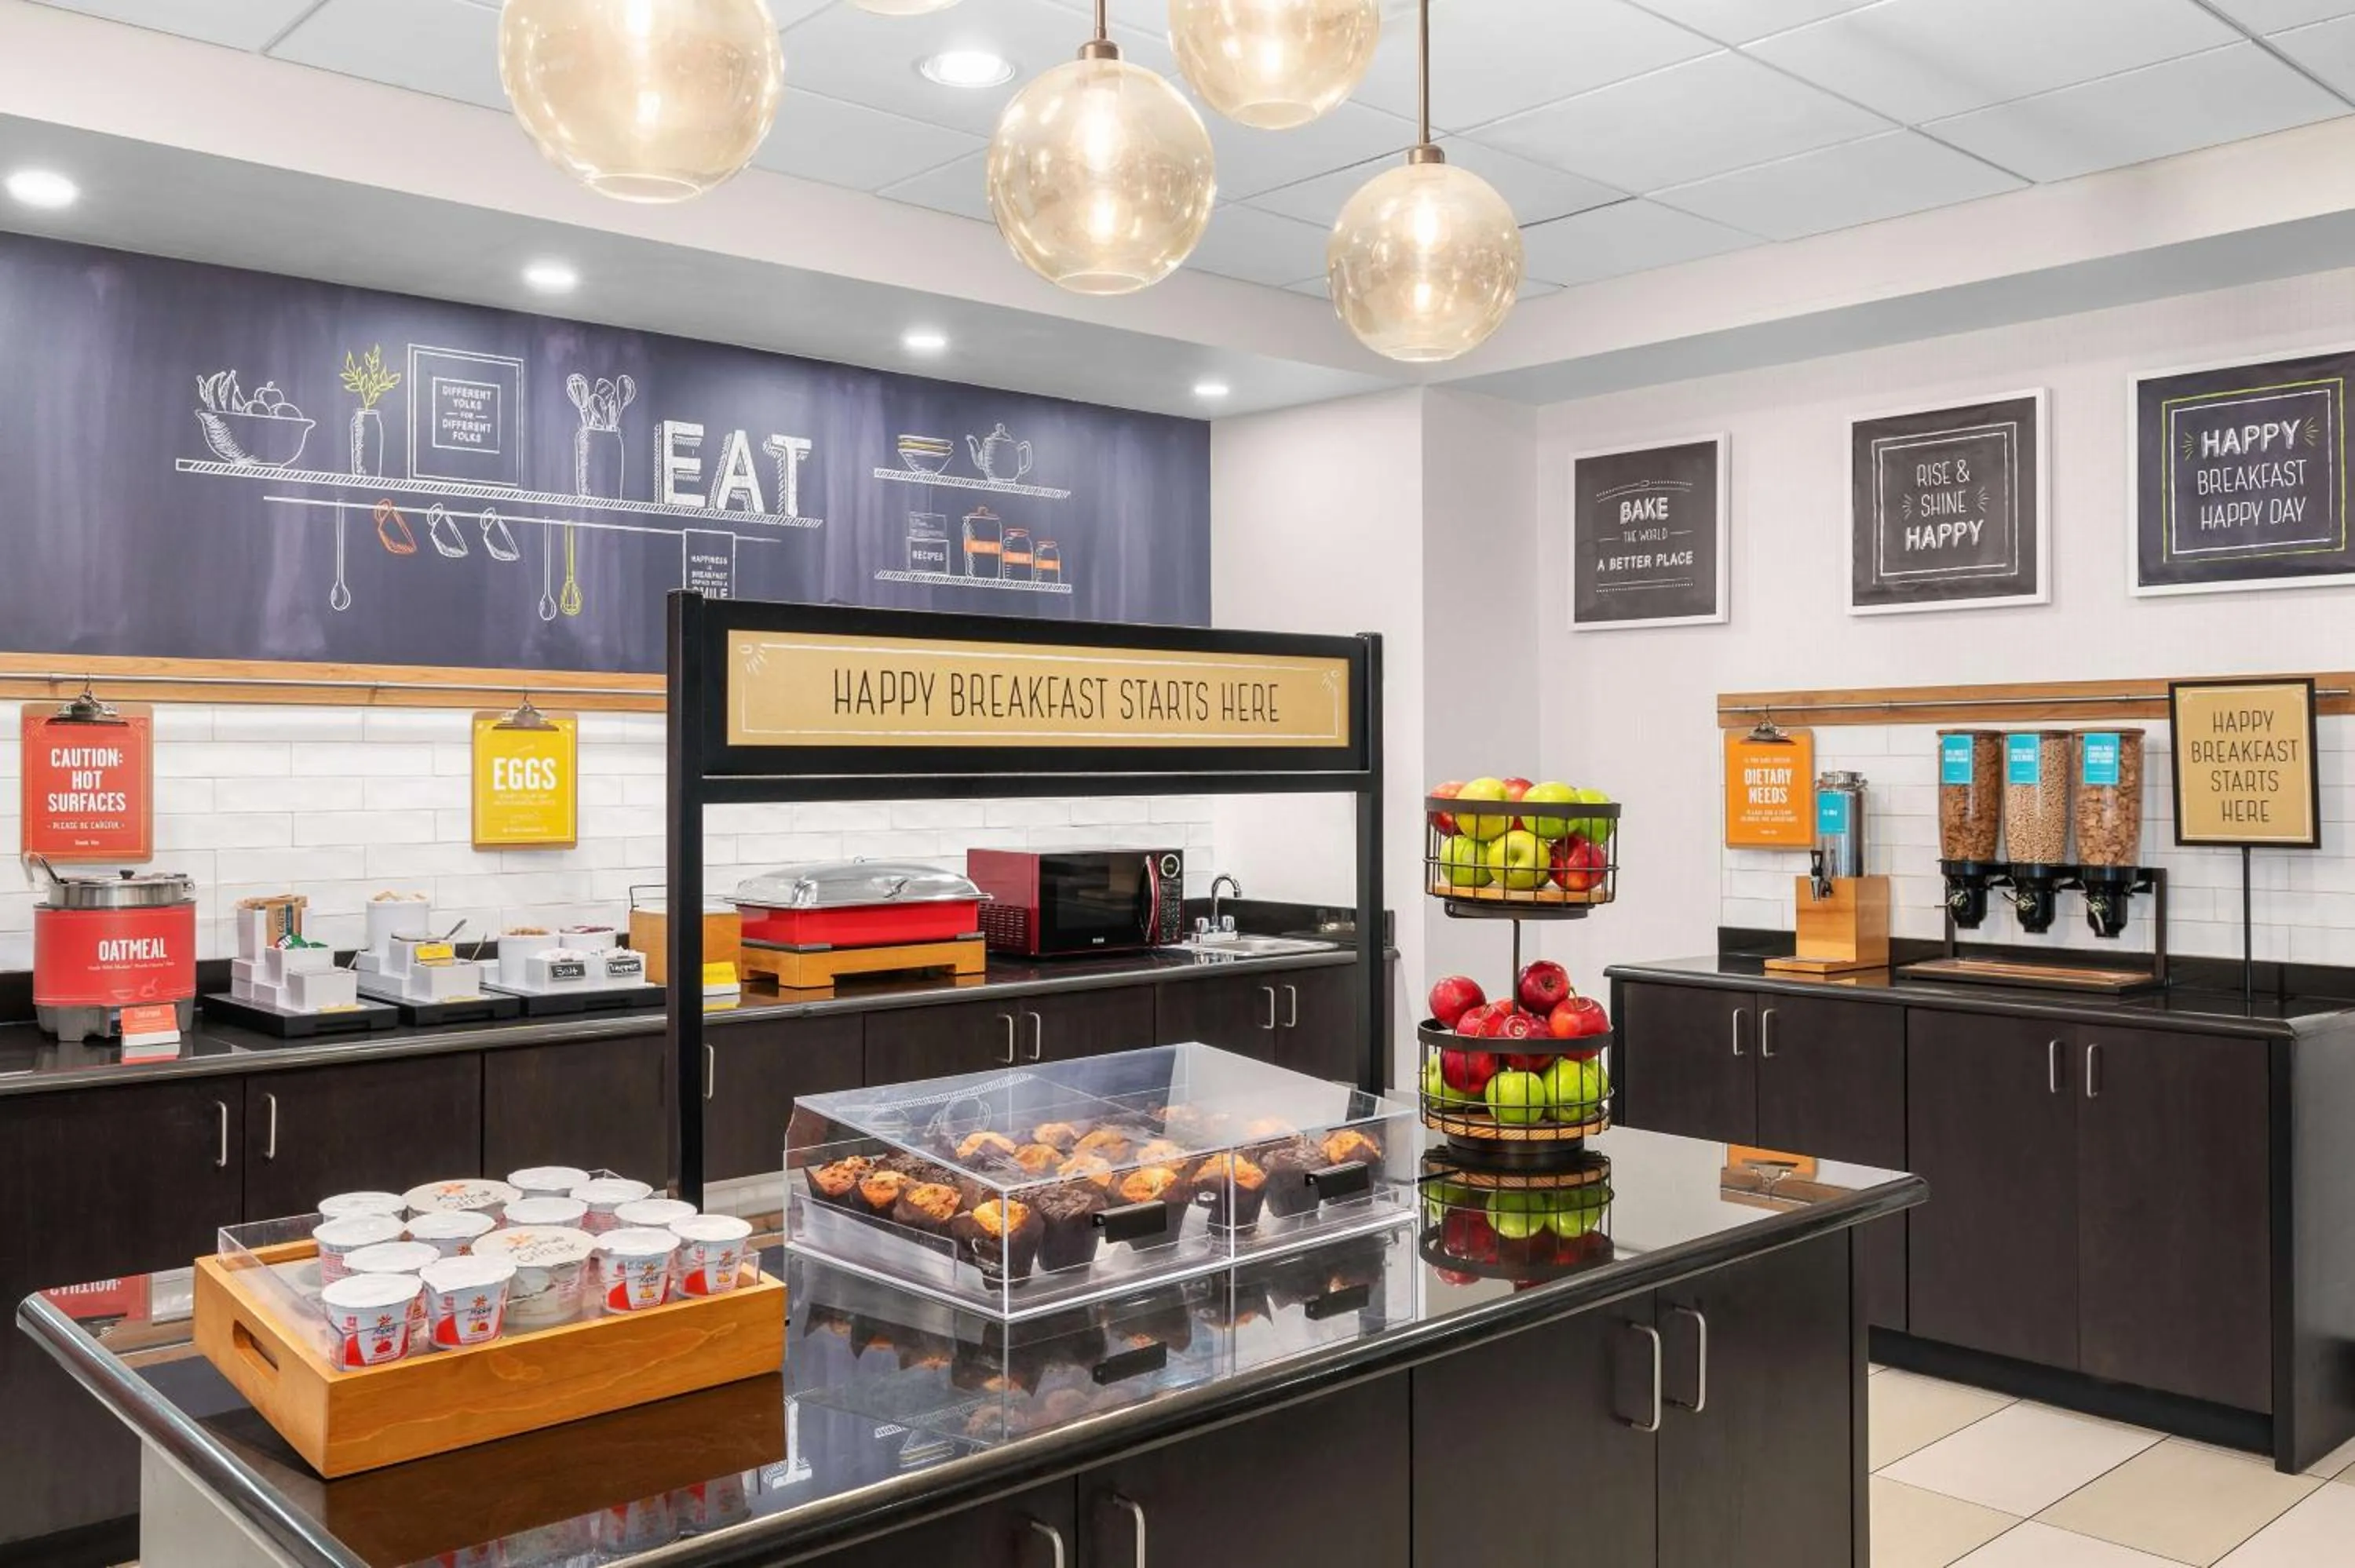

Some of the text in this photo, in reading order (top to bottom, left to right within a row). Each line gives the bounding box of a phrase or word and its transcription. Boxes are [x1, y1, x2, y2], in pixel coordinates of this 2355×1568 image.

[442, 385, 492, 401] DIFFERENT
[442, 418, 492, 434] DIFFERENT
[2201, 419, 2301, 459] HAPPY
[655, 420, 812, 518] EAT
[1916, 459, 1970, 487] RISE &
[2197, 459, 2307, 495] BREAKFAST
[1619, 497, 1670, 525] BAKE
[1921, 490, 1966, 517] SHINE
[2200, 497, 2307, 531] HAPPY DAY
[1623, 527, 1668, 543] THE WORLD
[1904, 520, 1984, 551] HAPPY
[1597, 551, 1693, 572] A BETTER PLACE
[833, 668, 1280, 723] HAPPY BREAKFAST STARTS HERE
[2213, 710, 2274, 733] HAPPY
[51, 748, 123, 768] CAUTION:
[2191, 739, 2298, 764] BREAKFAST
[71, 770, 103, 790] HOT
[492, 757, 557, 791] EGGS
[1744, 768, 1792, 786] DIETARY
[2211, 770, 2279, 792] STARTS
[48, 792, 126, 812] SURFACES
[1748, 787, 1788, 804] NEEDS
[2222, 800, 2270, 822] HERE
[98, 937, 168, 961] OATMEAL
